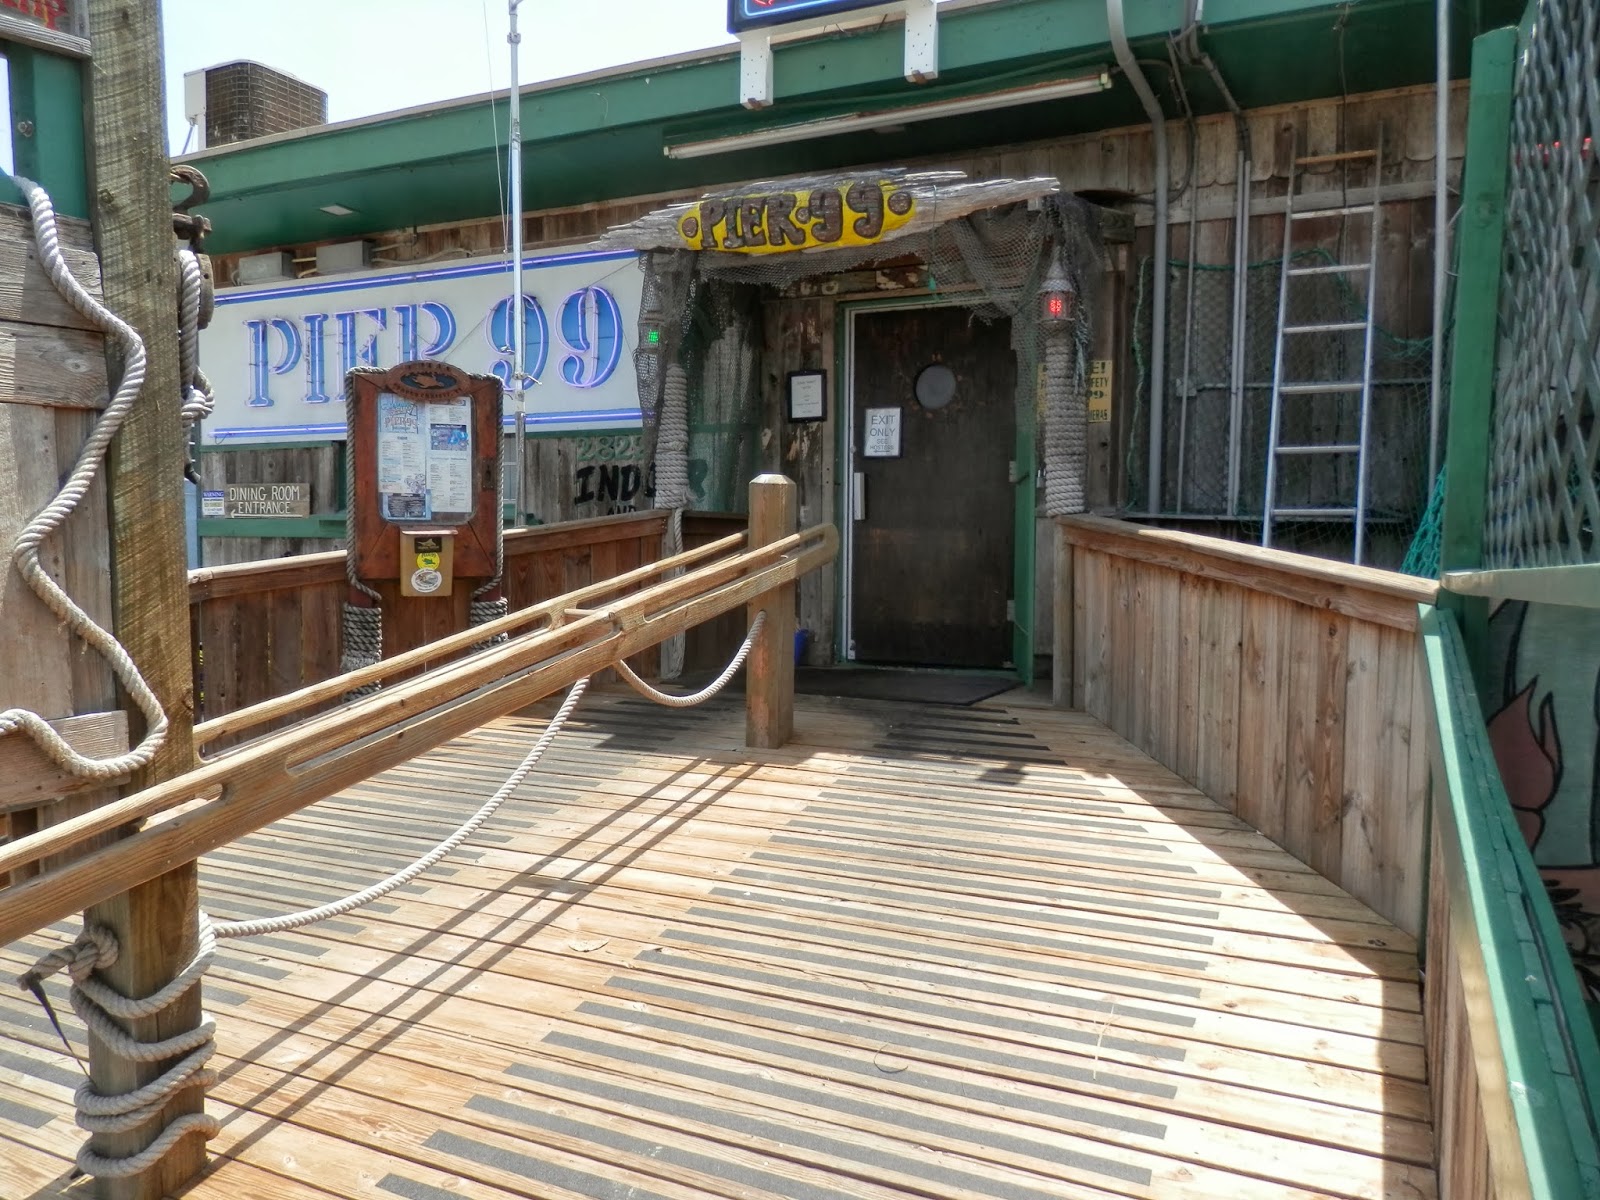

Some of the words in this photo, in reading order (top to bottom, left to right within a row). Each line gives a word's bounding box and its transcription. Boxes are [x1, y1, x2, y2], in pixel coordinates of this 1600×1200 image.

[699, 194, 806, 249] PIER
[809, 183, 884, 243] 99
[243, 301, 457, 408] PIER
[485, 286, 622, 392] 99
[871, 415, 896, 425] EXIT
[869, 428, 896, 437] ONLY
[229, 486, 267, 501] DINING
[271, 485, 300, 501] ROOM
[238, 501, 291, 514] ENTRANCE
